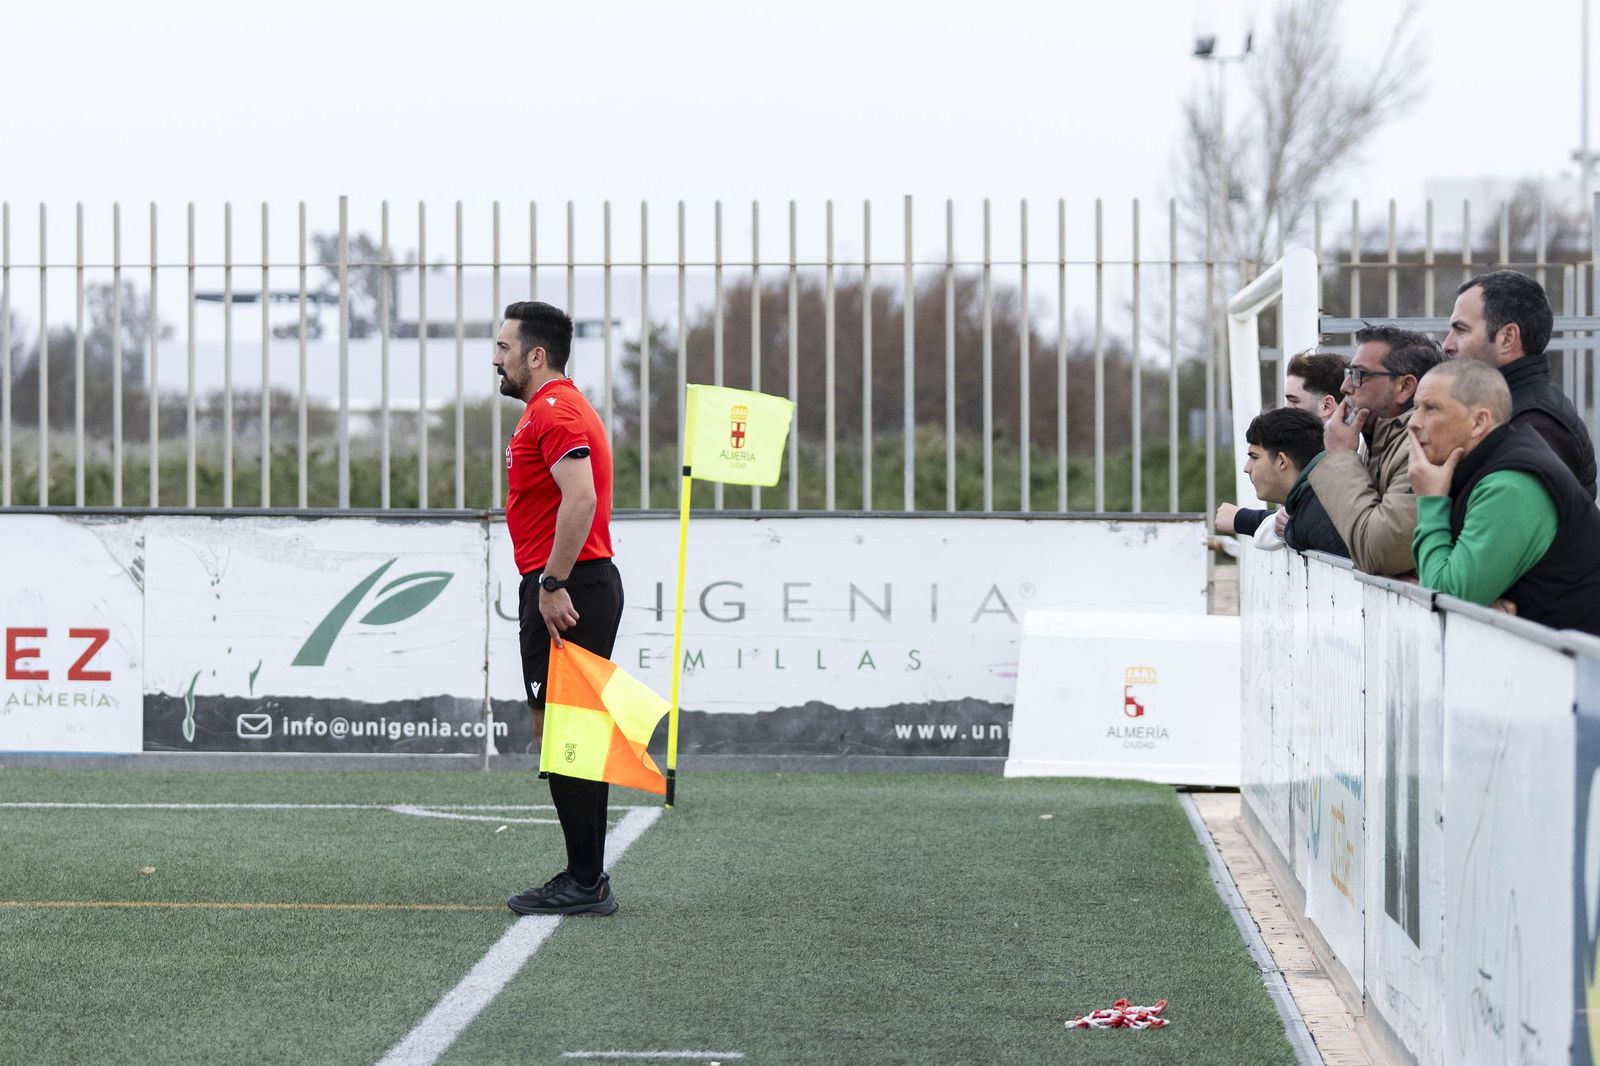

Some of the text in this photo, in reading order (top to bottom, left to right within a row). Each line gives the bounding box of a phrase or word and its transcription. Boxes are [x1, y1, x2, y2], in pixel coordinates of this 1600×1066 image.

[494, 579, 1019, 624] UIGENIA
[5, 627, 112, 682] EZ
[638, 647, 923, 673] EMILLAS
[5, 688, 112, 708] ALMERÍA
[282, 716, 509, 740] info@unigenia.com
[1105, 724, 1170, 740] ALMERÍA
